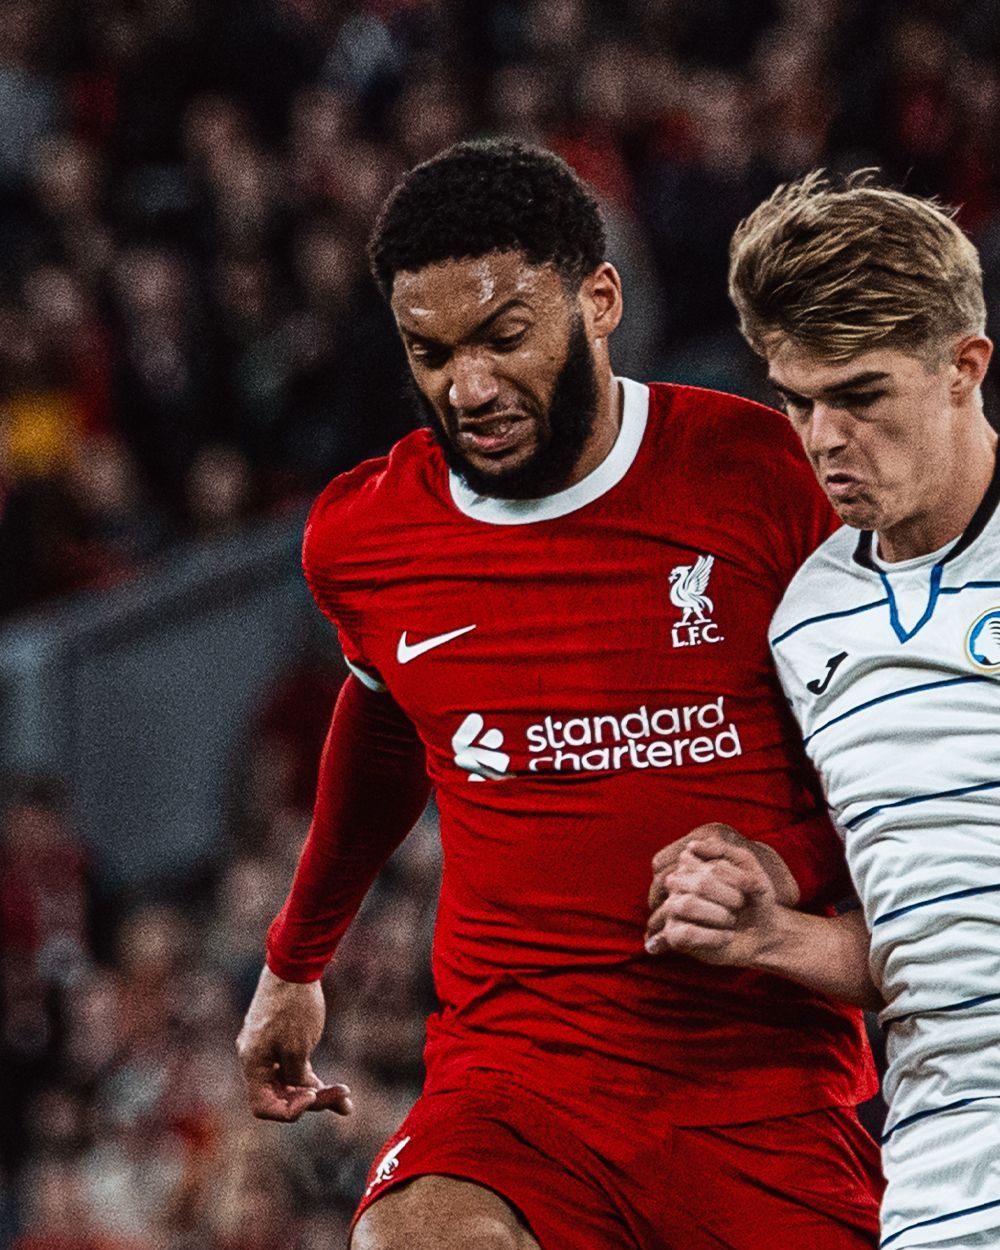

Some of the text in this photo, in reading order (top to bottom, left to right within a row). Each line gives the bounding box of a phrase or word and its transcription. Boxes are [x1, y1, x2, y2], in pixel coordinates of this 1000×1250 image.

[671, 623, 725, 648] L.F.C.
[526, 696, 725, 752] standard
[528, 723, 742, 772] chartered
